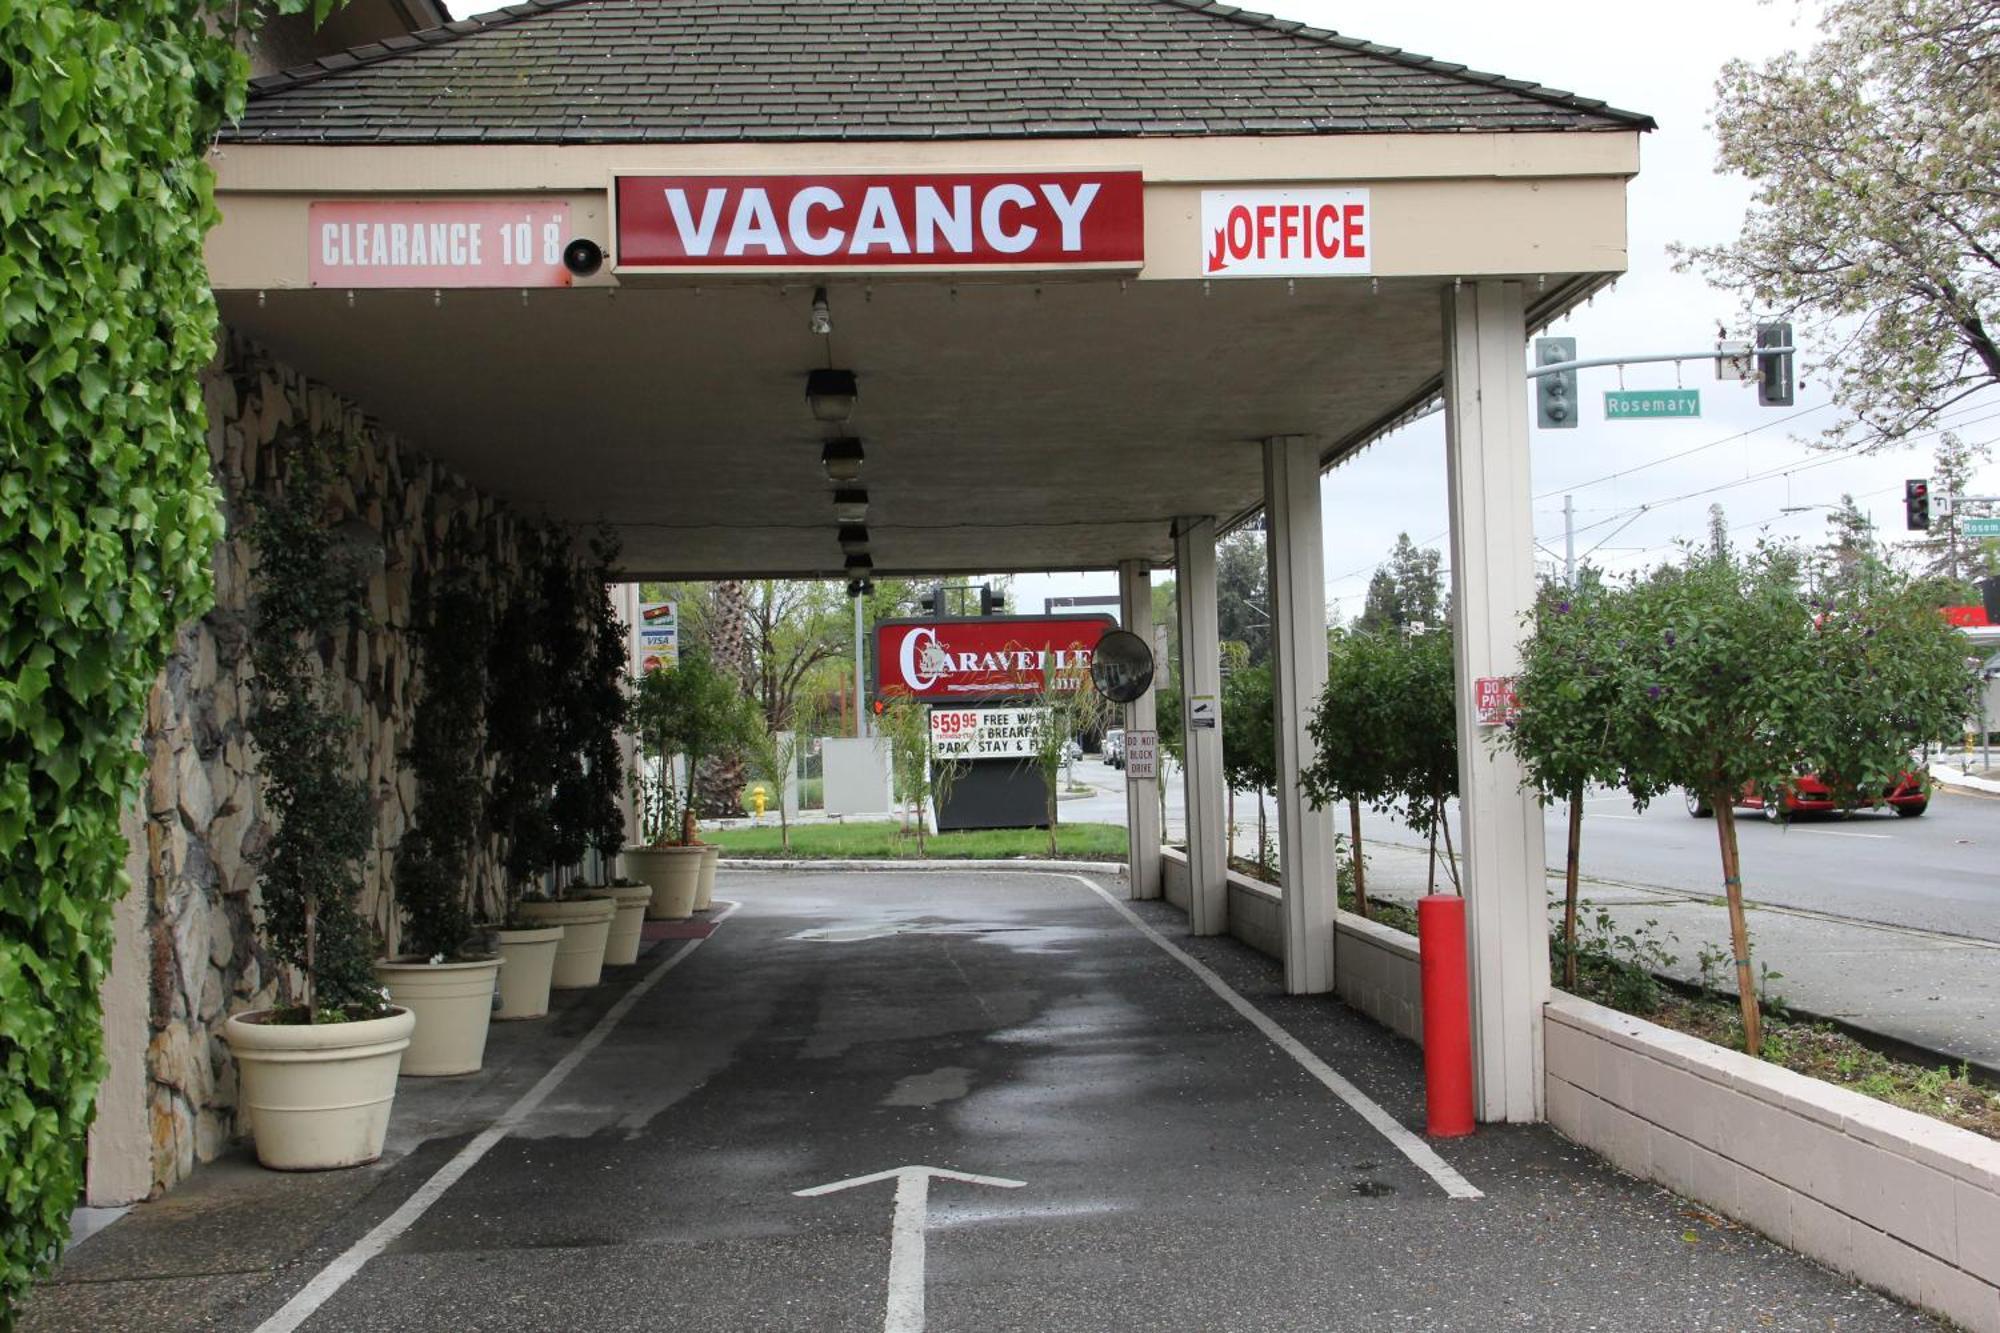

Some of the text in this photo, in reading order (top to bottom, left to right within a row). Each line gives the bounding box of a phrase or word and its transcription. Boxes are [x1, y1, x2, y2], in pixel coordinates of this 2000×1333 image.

[665, 183, 1101, 256] VACANCY
[1227, 204, 1365, 260] OFFICE
[322, 213, 482, 266] CLEARANCE
[1608, 398, 1697, 414] Rosemary
[647, 636, 669, 645] VISA
[900, 627, 1093, 691] CARAVELLE
[1483, 681, 1499, 694] DO
[983, 714, 1009, 725] FREE
[938, 741, 969, 754] PARK
[978, 740, 1009, 753] STAY
[1016, 739, 1024, 751] &
[1127, 736, 1155, 746] DO NOT
[1130, 750, 1153, 760] BLOCK
[1131, 763, 1153, 773] DRIVE
